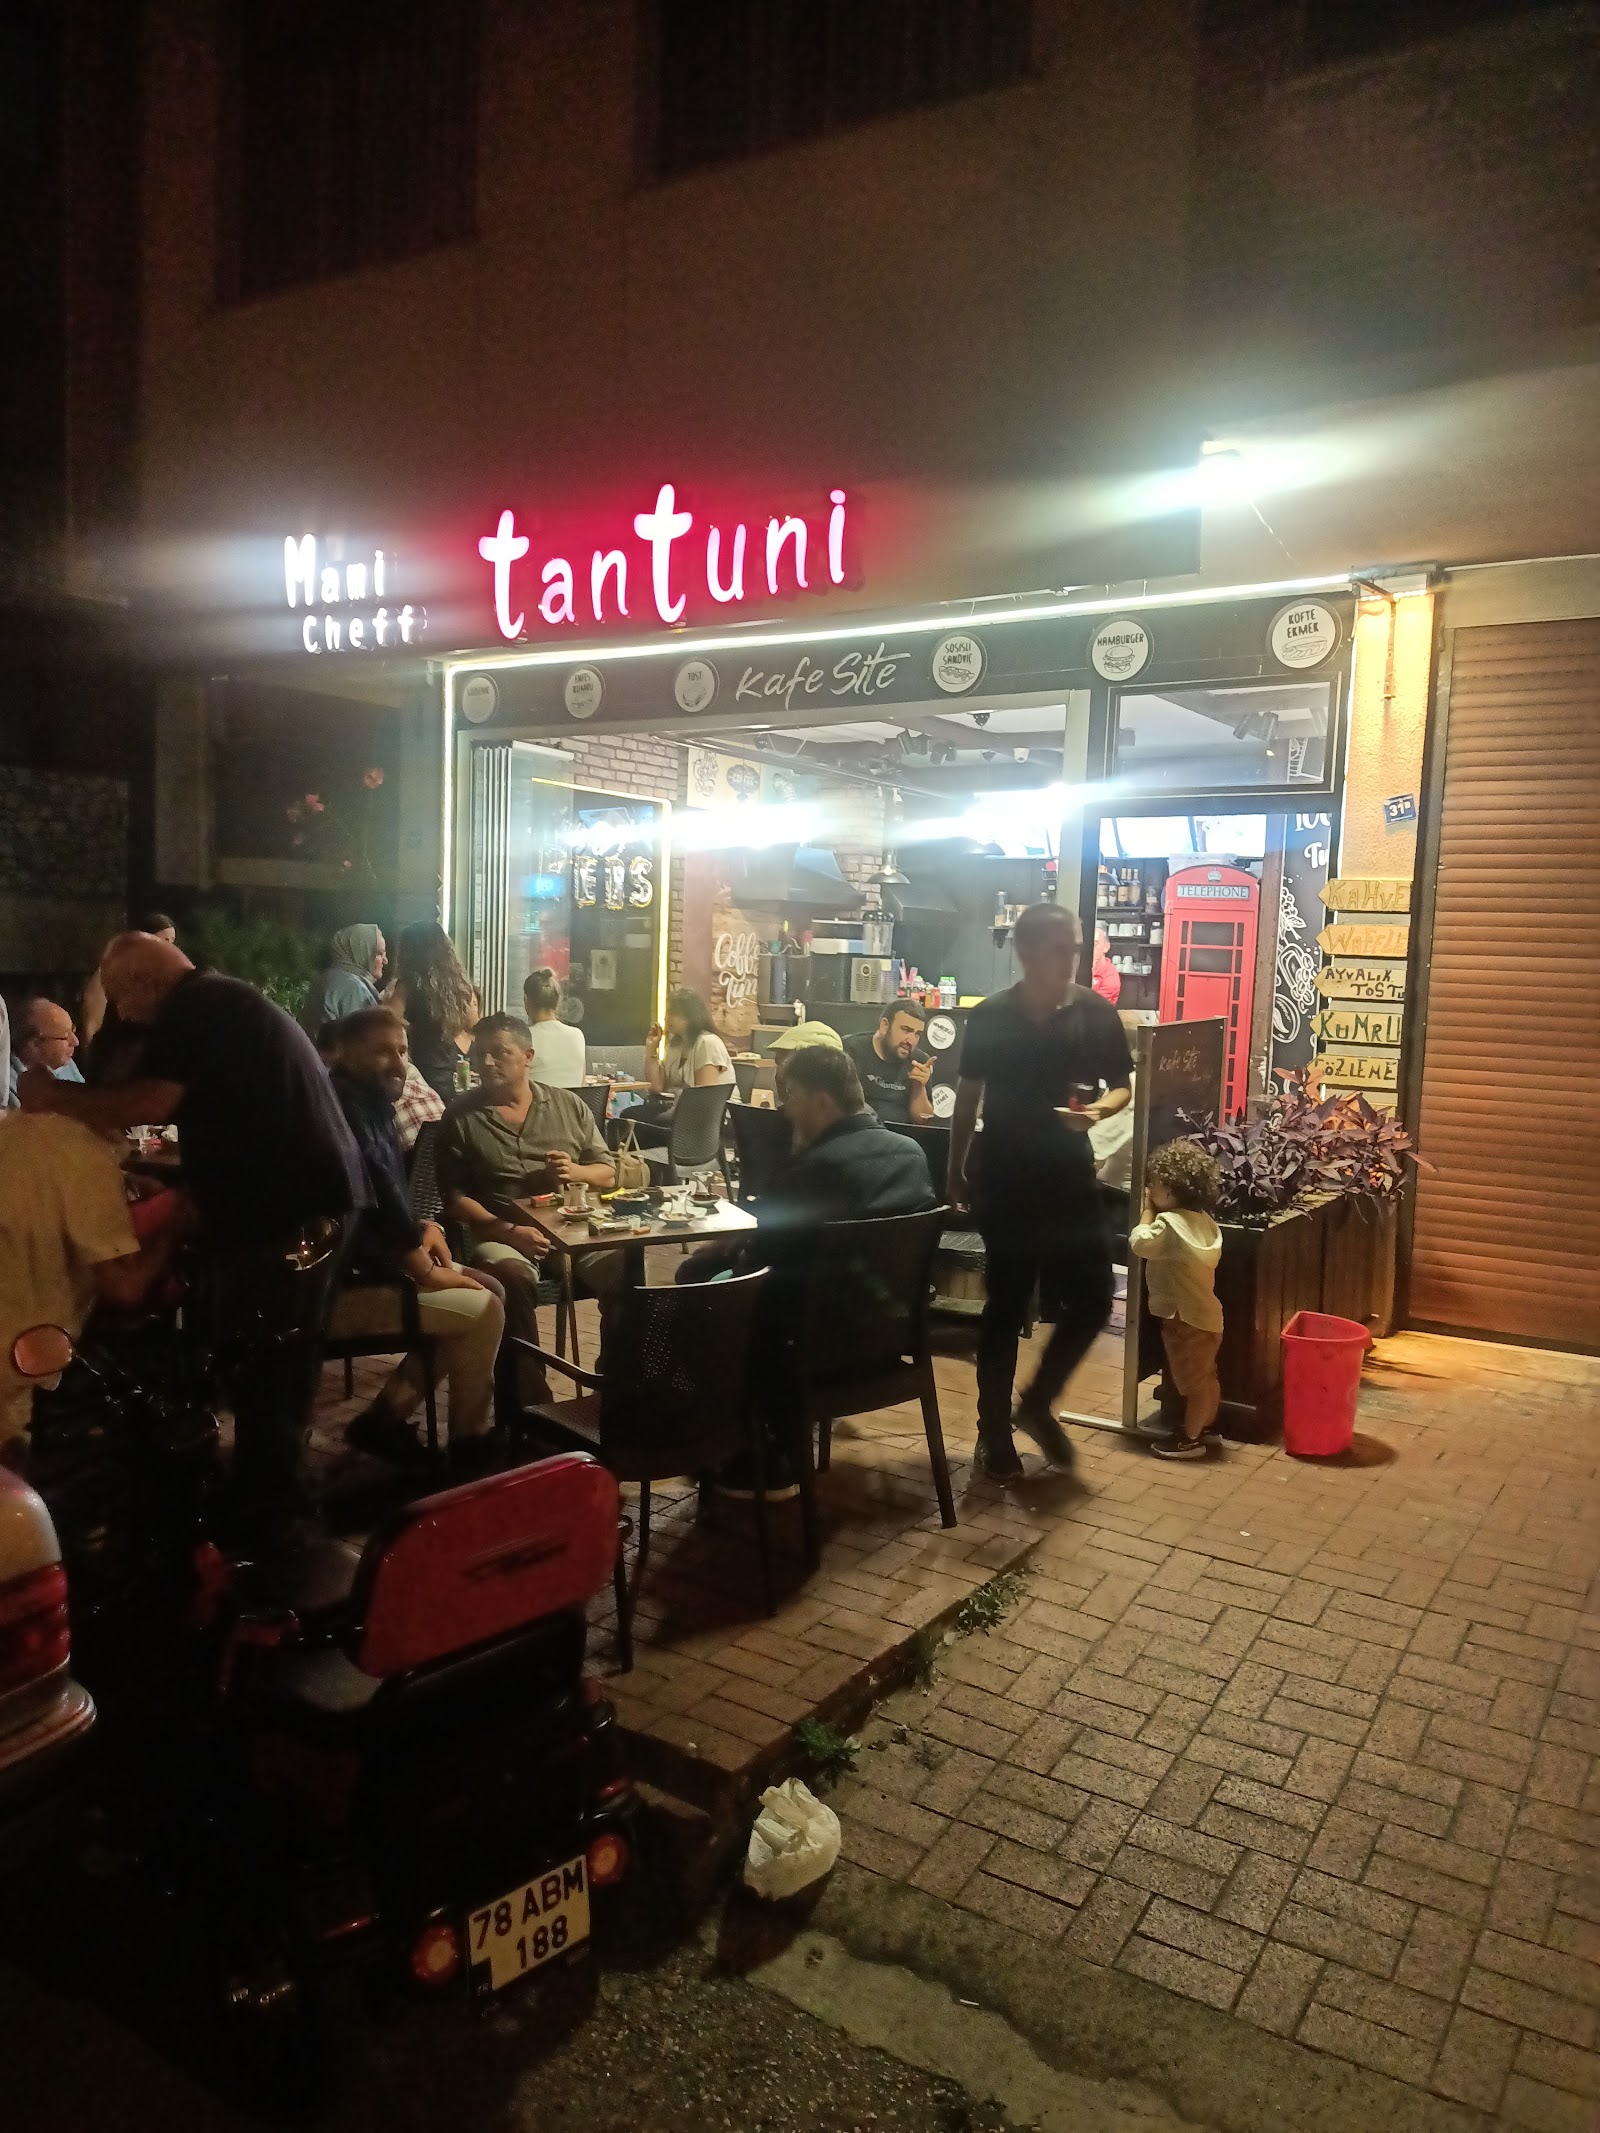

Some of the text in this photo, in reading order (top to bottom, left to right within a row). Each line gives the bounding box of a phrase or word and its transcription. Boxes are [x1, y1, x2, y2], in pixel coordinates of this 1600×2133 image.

[478, 483, 845, 639] tantuni
[1097, 633, 1145, 646] HAMBURGER
[1287, 622, 1319, 638] EKMEK
[830, 642, 911, 696] Site
[1180, 886, 1247, 898] TELEPHONE
[473, 1861, 584, 1949] 78 ABM
[517, 1915, 568, 1969] 188
